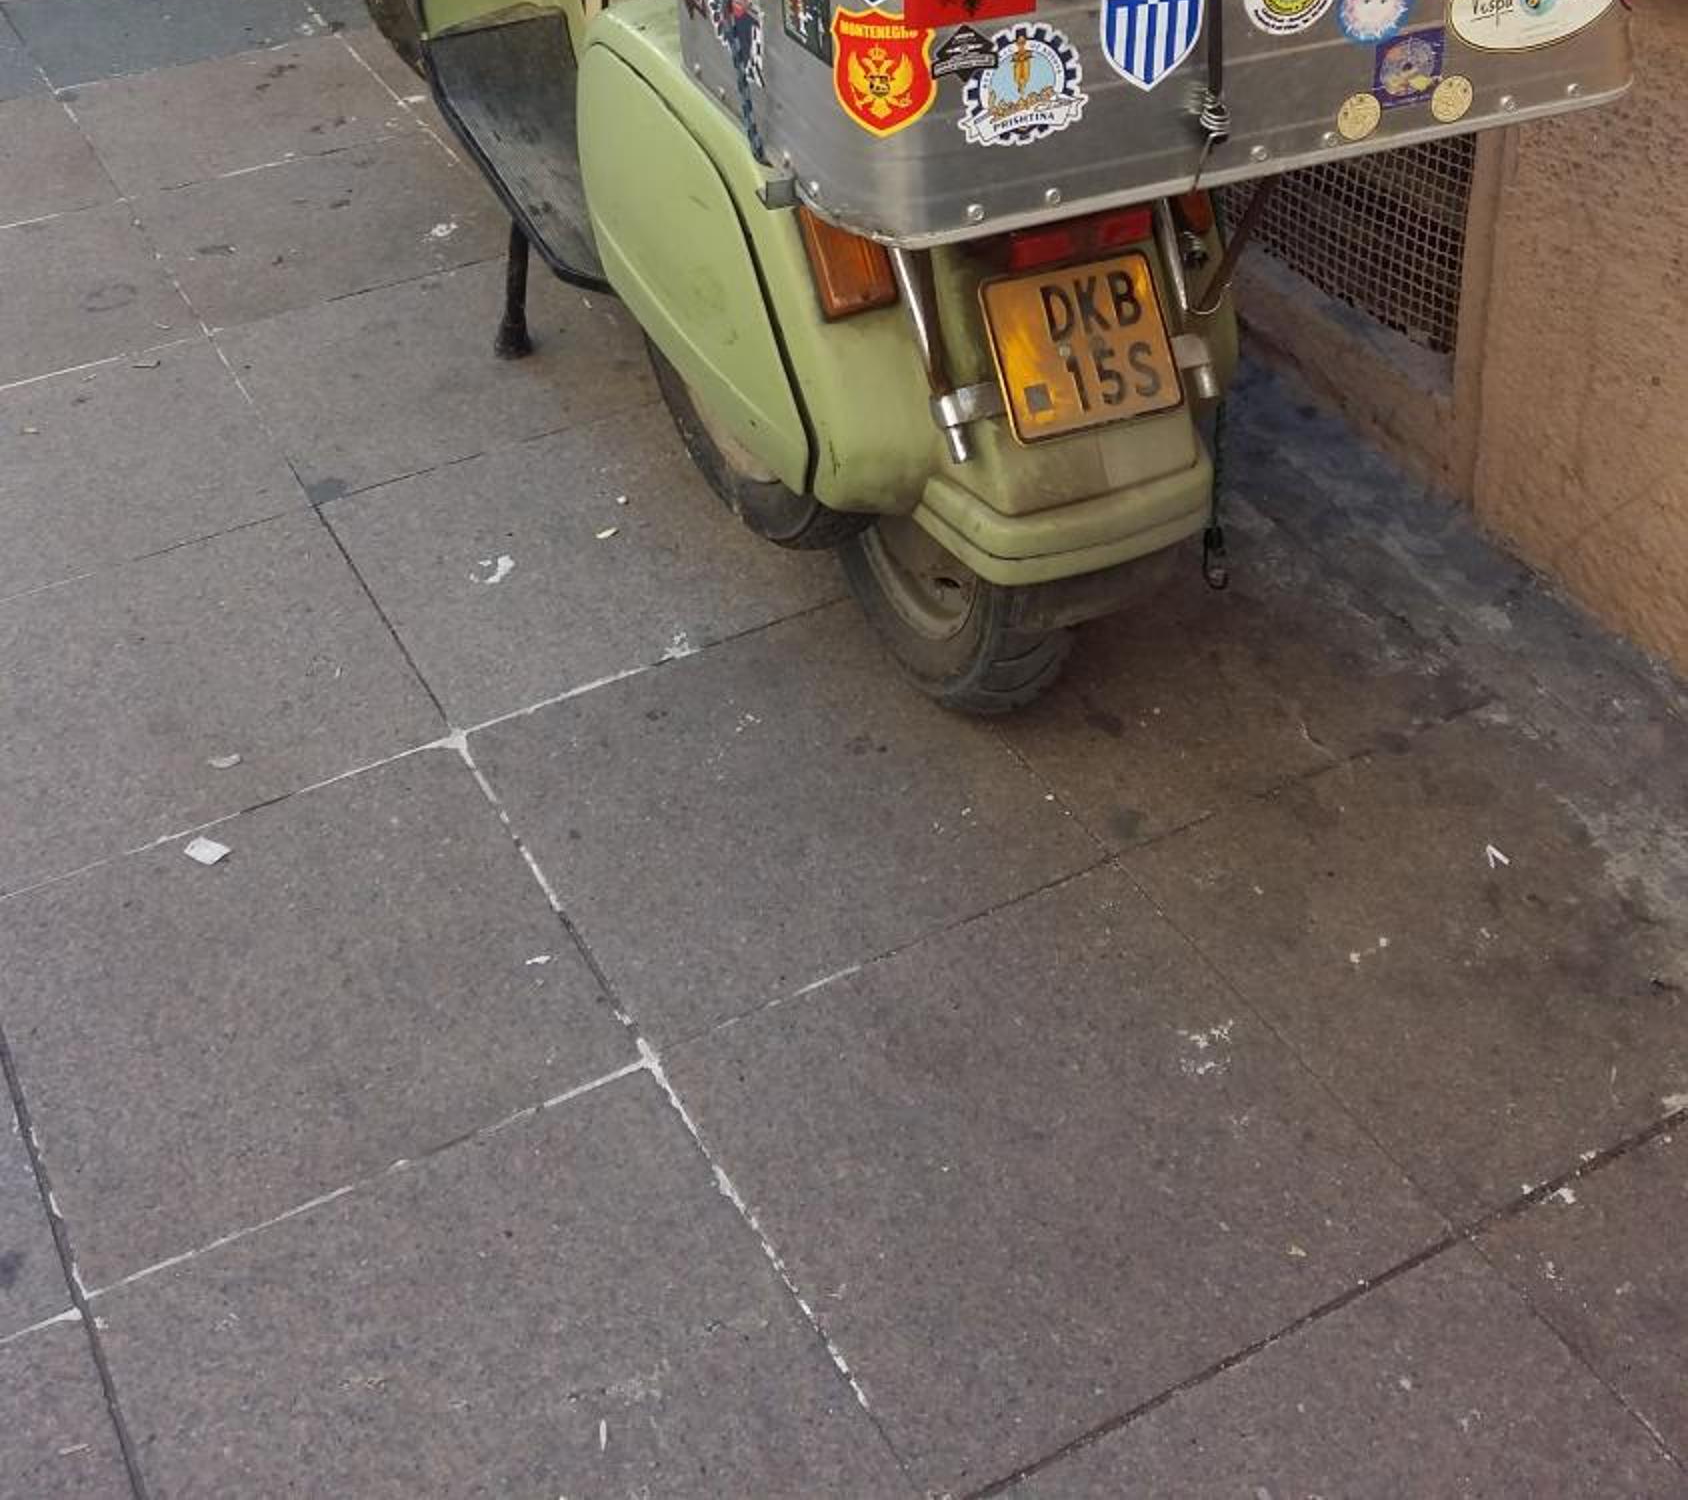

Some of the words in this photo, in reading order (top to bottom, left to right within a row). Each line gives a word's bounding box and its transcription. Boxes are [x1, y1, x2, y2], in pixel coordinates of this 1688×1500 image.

[992, 111, 1056, 133] PRISHTINA
[1039, 270, 1142, 342] DKB
[1063, 341, 1162, 414] 15S
